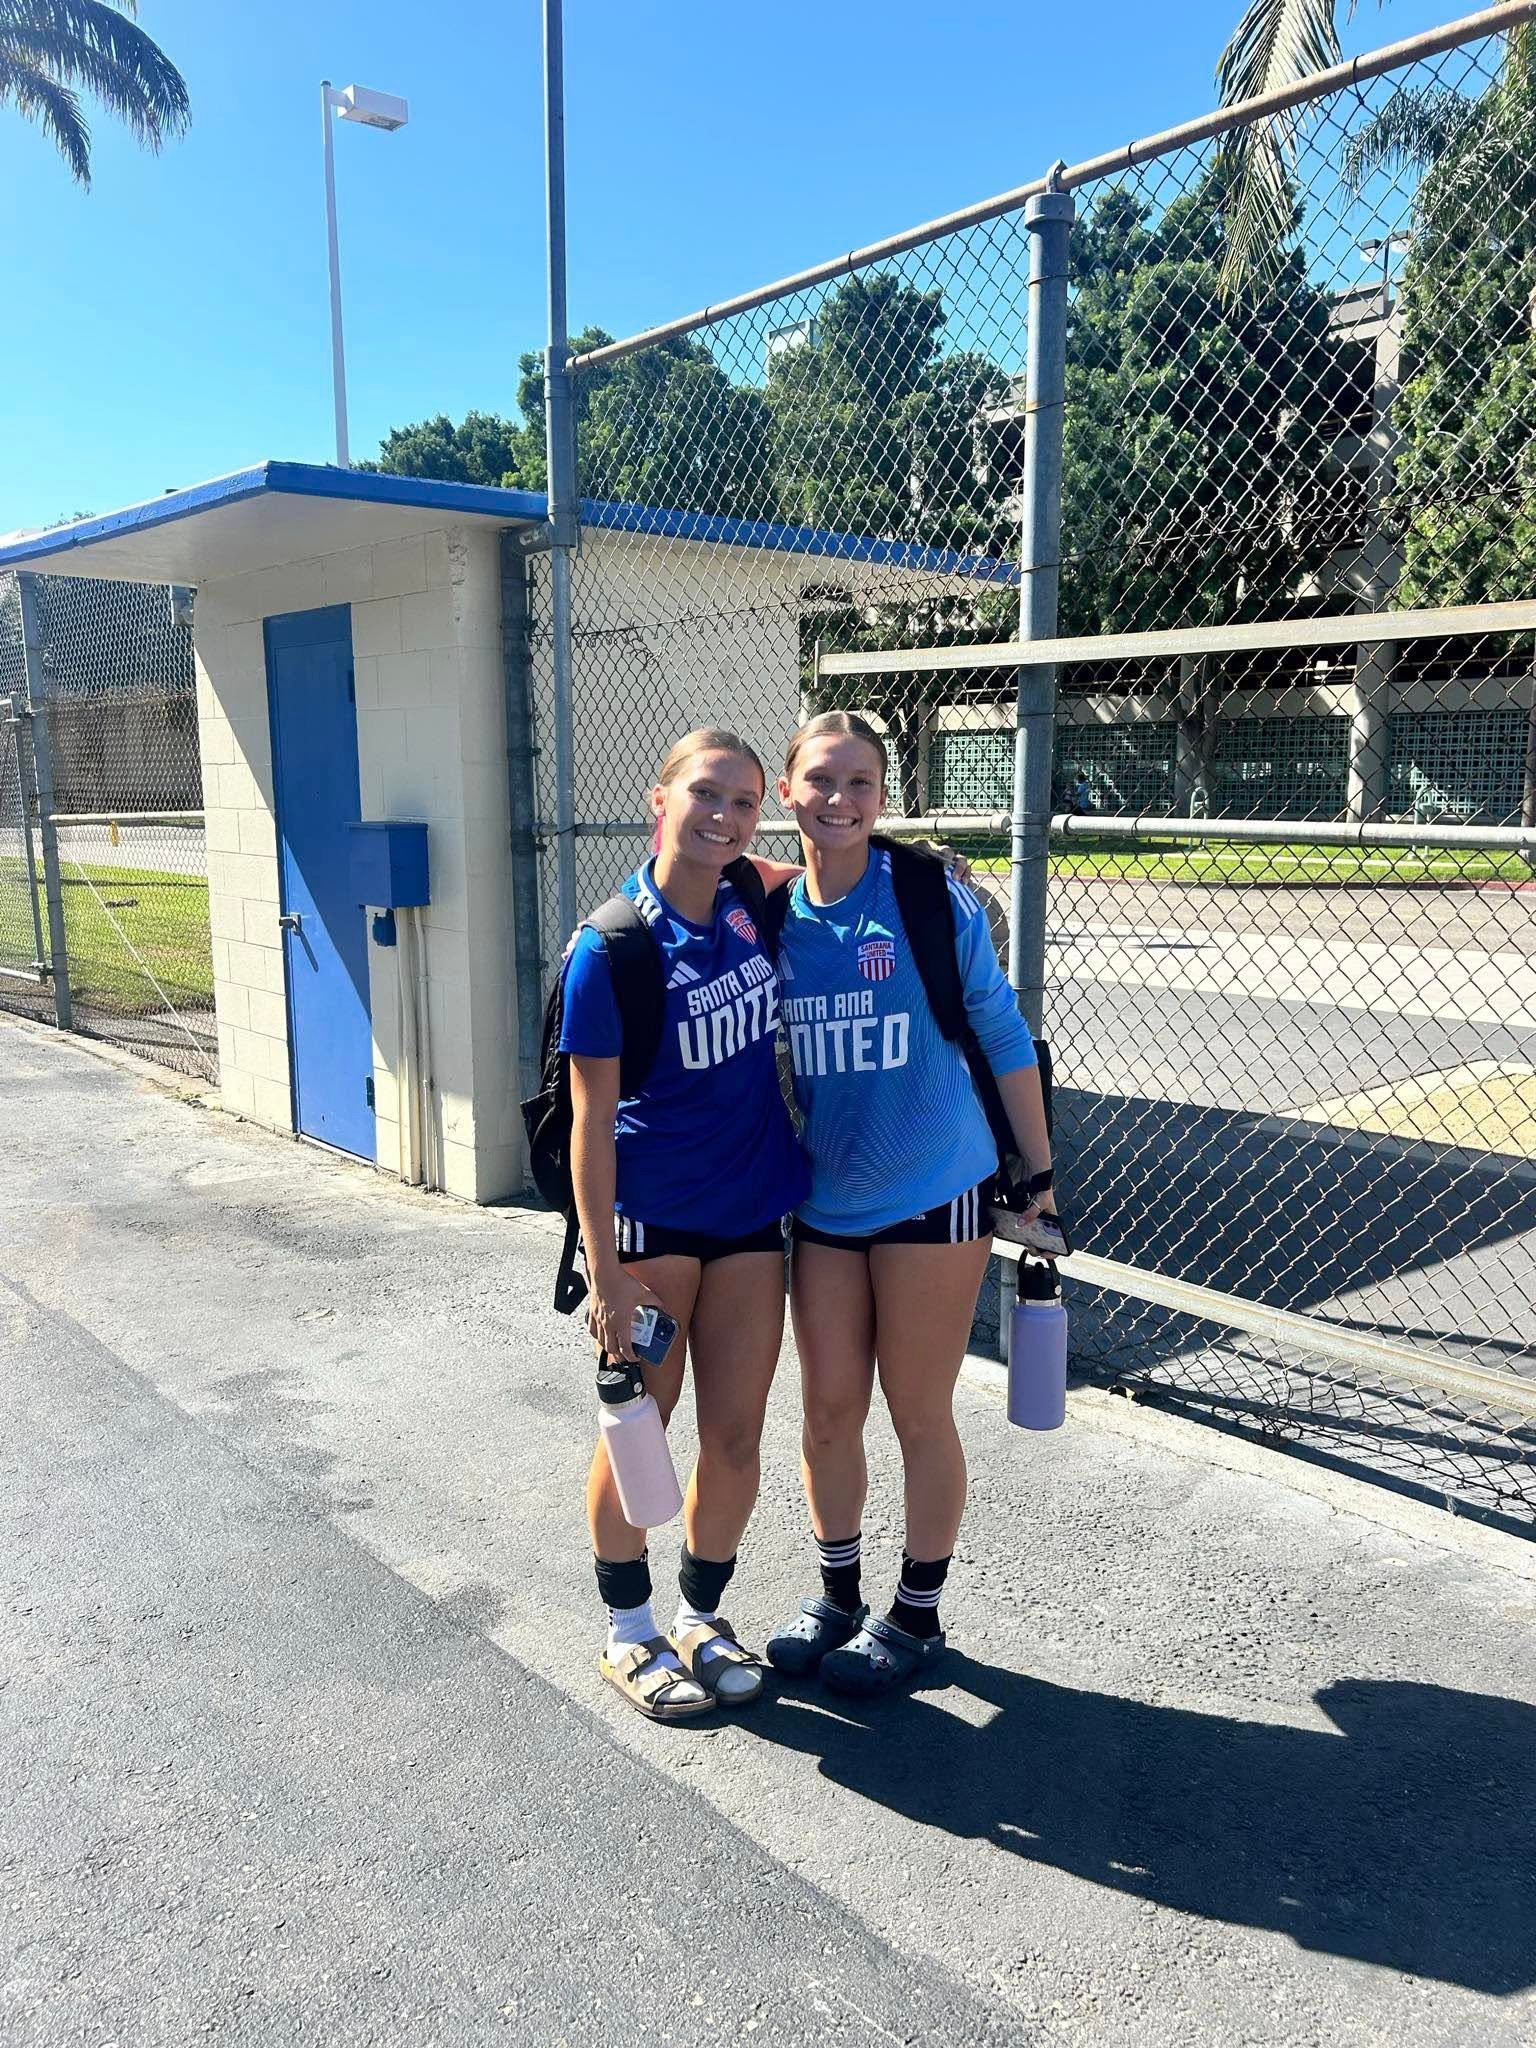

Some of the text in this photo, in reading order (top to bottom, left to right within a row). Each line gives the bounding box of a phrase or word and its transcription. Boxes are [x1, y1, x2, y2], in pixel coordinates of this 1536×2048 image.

[686, 954, 773, 1017] SANTA ANA
[834, 989, 873, 1018] ANA
[677, 975, 781, 1069] UNITE
[789, 1012, 910, 1076] NITED
